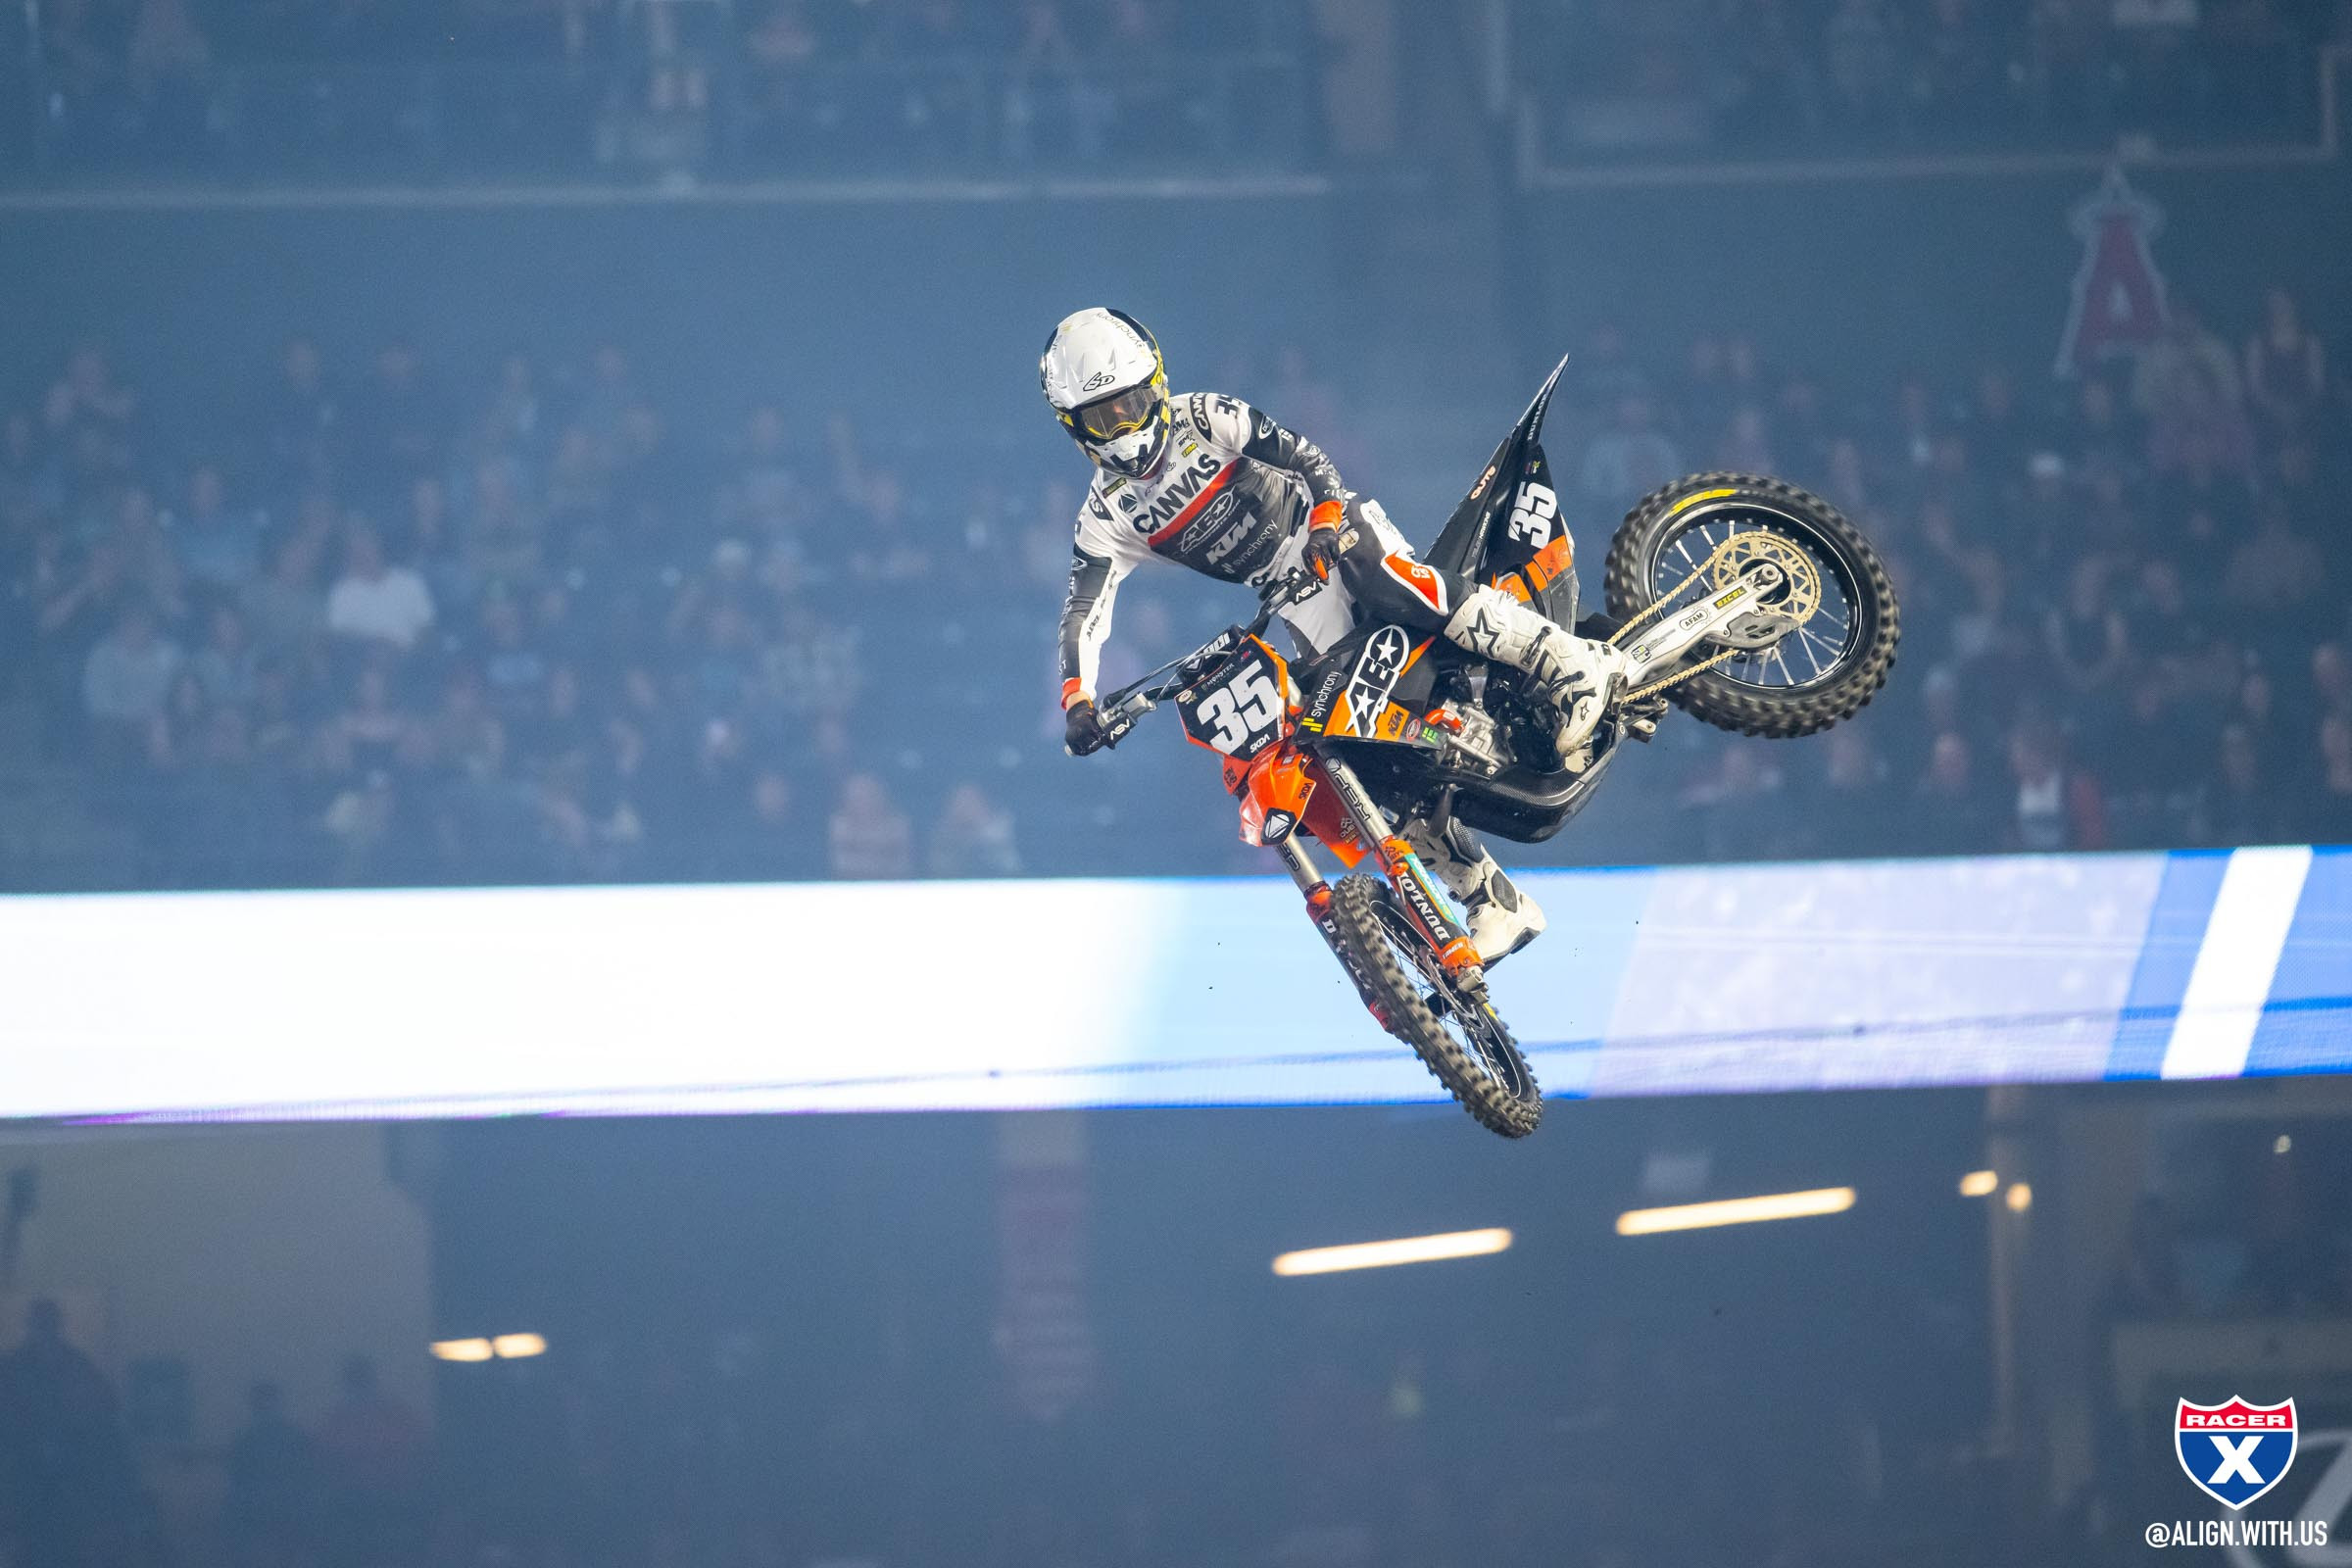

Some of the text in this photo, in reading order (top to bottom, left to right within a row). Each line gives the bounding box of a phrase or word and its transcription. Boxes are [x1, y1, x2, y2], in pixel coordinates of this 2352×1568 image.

[1133, 454, 1221, 534] CANVAS
[1508, 481, 1558, 549] 35
[1206, 512, 1257, 564] KTM
[1233, 519, 1279, 565] synchrony
[1684, 612, 1704, 627] AFAM
[1715, 588, 1744, 608] EXCEL
[1197, 660, 1280, 755] 35
[1311, 670, 1343, 717] synchrony
[1388, 710, 1405, 737] KTM
